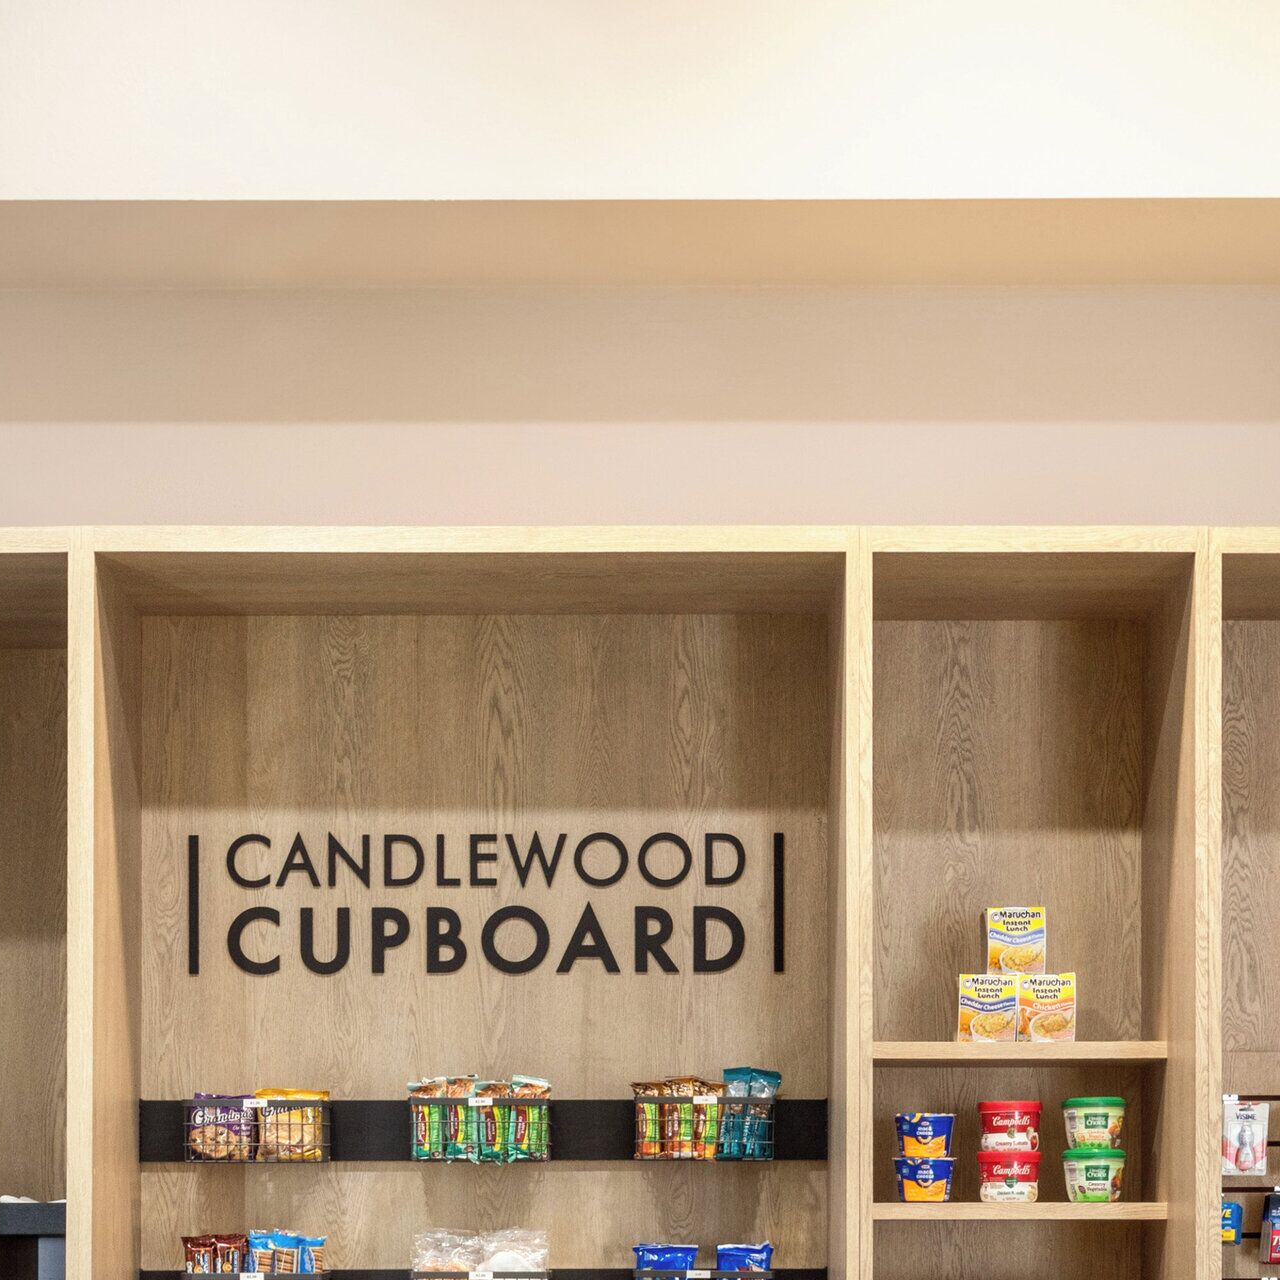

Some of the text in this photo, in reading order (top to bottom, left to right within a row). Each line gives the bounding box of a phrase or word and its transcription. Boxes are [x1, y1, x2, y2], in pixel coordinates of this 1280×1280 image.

[225, 831, 746, 888] CANDLEWOOD
[227, 902, 746, 975] CUPBOARD
[972, 978, 1013, 986] Maruchan
[1030, 978, 1071, 986] Maruchan
